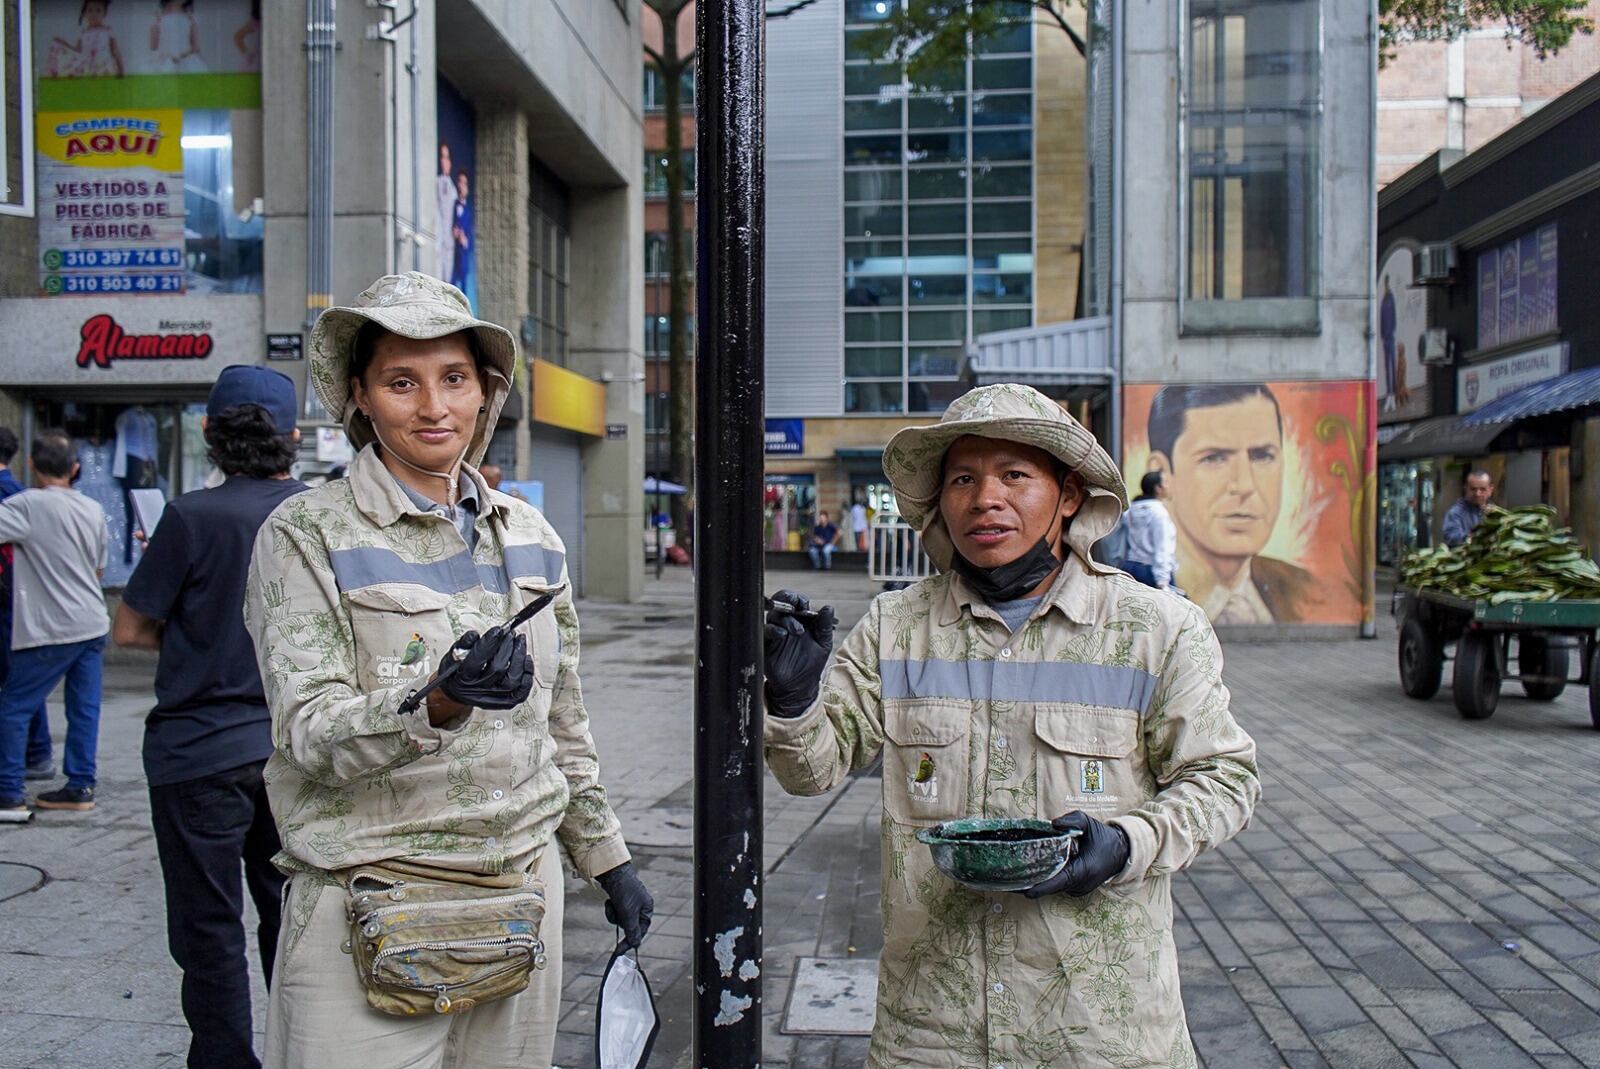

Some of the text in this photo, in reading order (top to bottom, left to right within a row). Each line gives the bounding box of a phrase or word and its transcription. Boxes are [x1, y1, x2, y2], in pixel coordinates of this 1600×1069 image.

[55, 118, 160, 136] COMPRE
[55, 182, 167, 197] VESTIDOS A
[56, 203, 168, 218] PRECIOS DE
[67, 253, 97, 265] 310
[102, 252, 131, 265] 397
[136, 251, 156, 264] 74
[67, 277, 179, 291] 310 503 40 21
[158, 319, 213, 331] Mercado
[76, 314, 214, 369] Alamano
[376, 655, 401, 663] Parque
